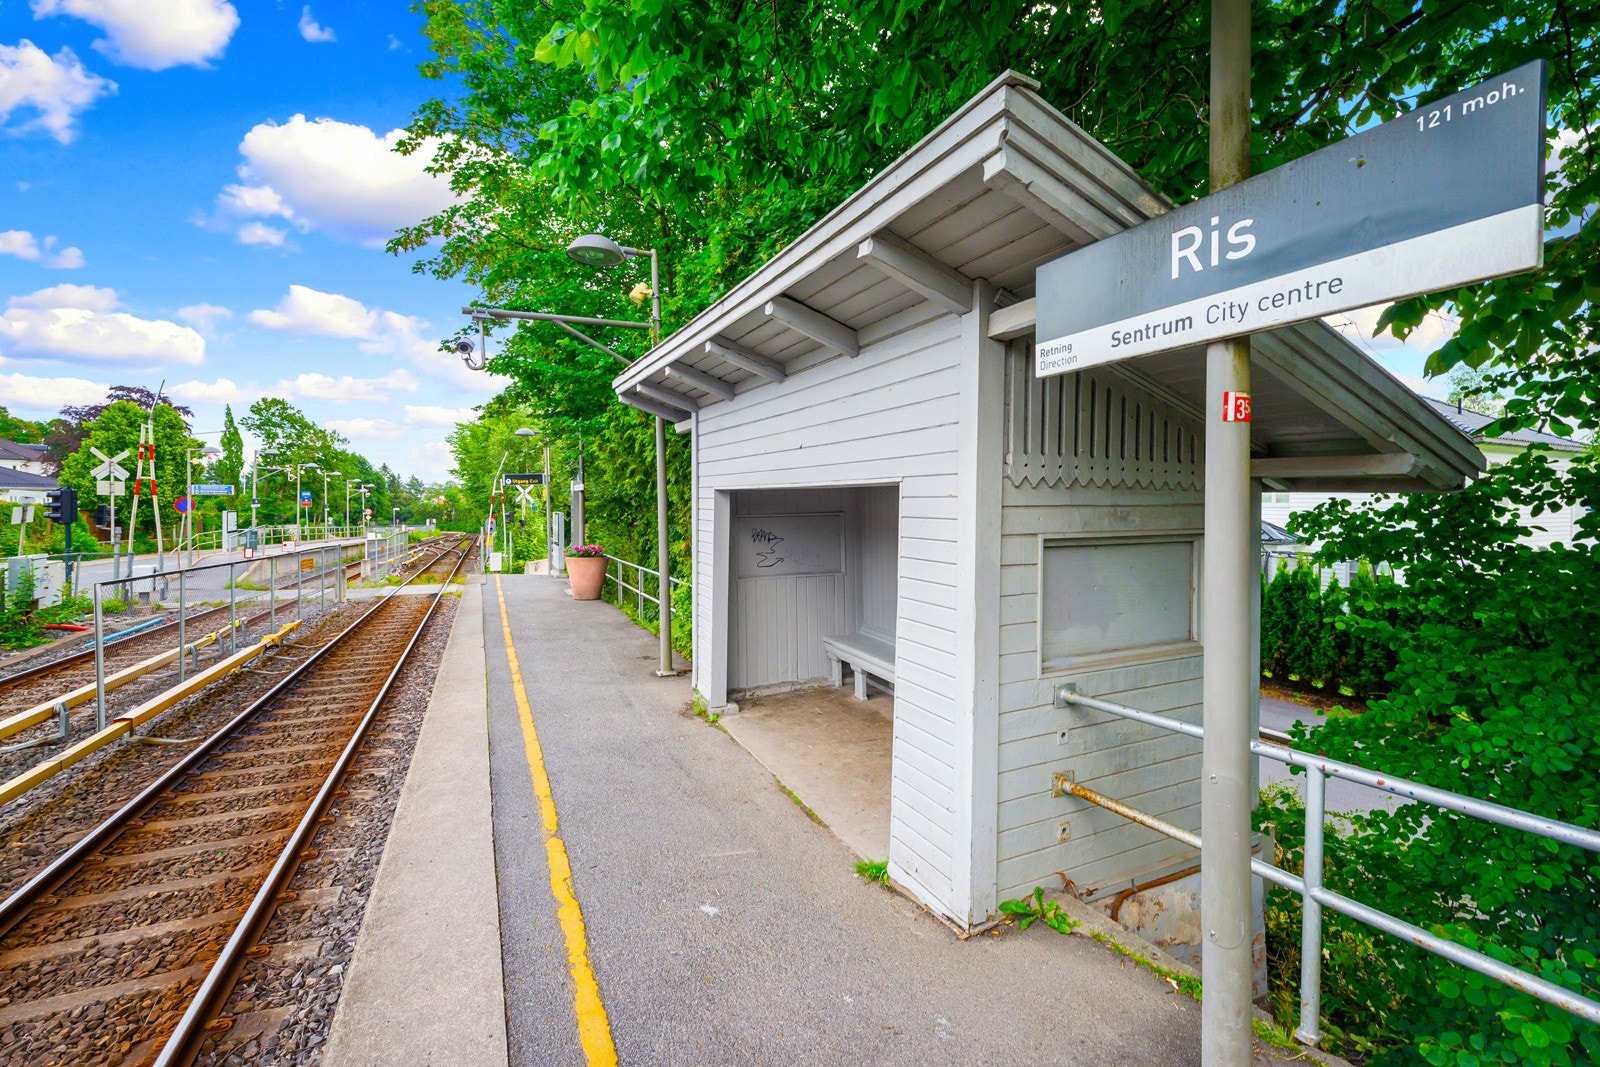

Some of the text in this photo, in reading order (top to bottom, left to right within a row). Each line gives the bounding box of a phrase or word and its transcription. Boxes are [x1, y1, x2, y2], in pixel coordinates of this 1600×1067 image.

[1416, 82, 1525, 132] 121 moh.
[1171, 215, 1257, 280] Ris
[1110, 277, 1343, 348] Sentrum City centre
[1040, 343, 1073, 359] Retning
[1040, 354, 1078, 371] Direction
